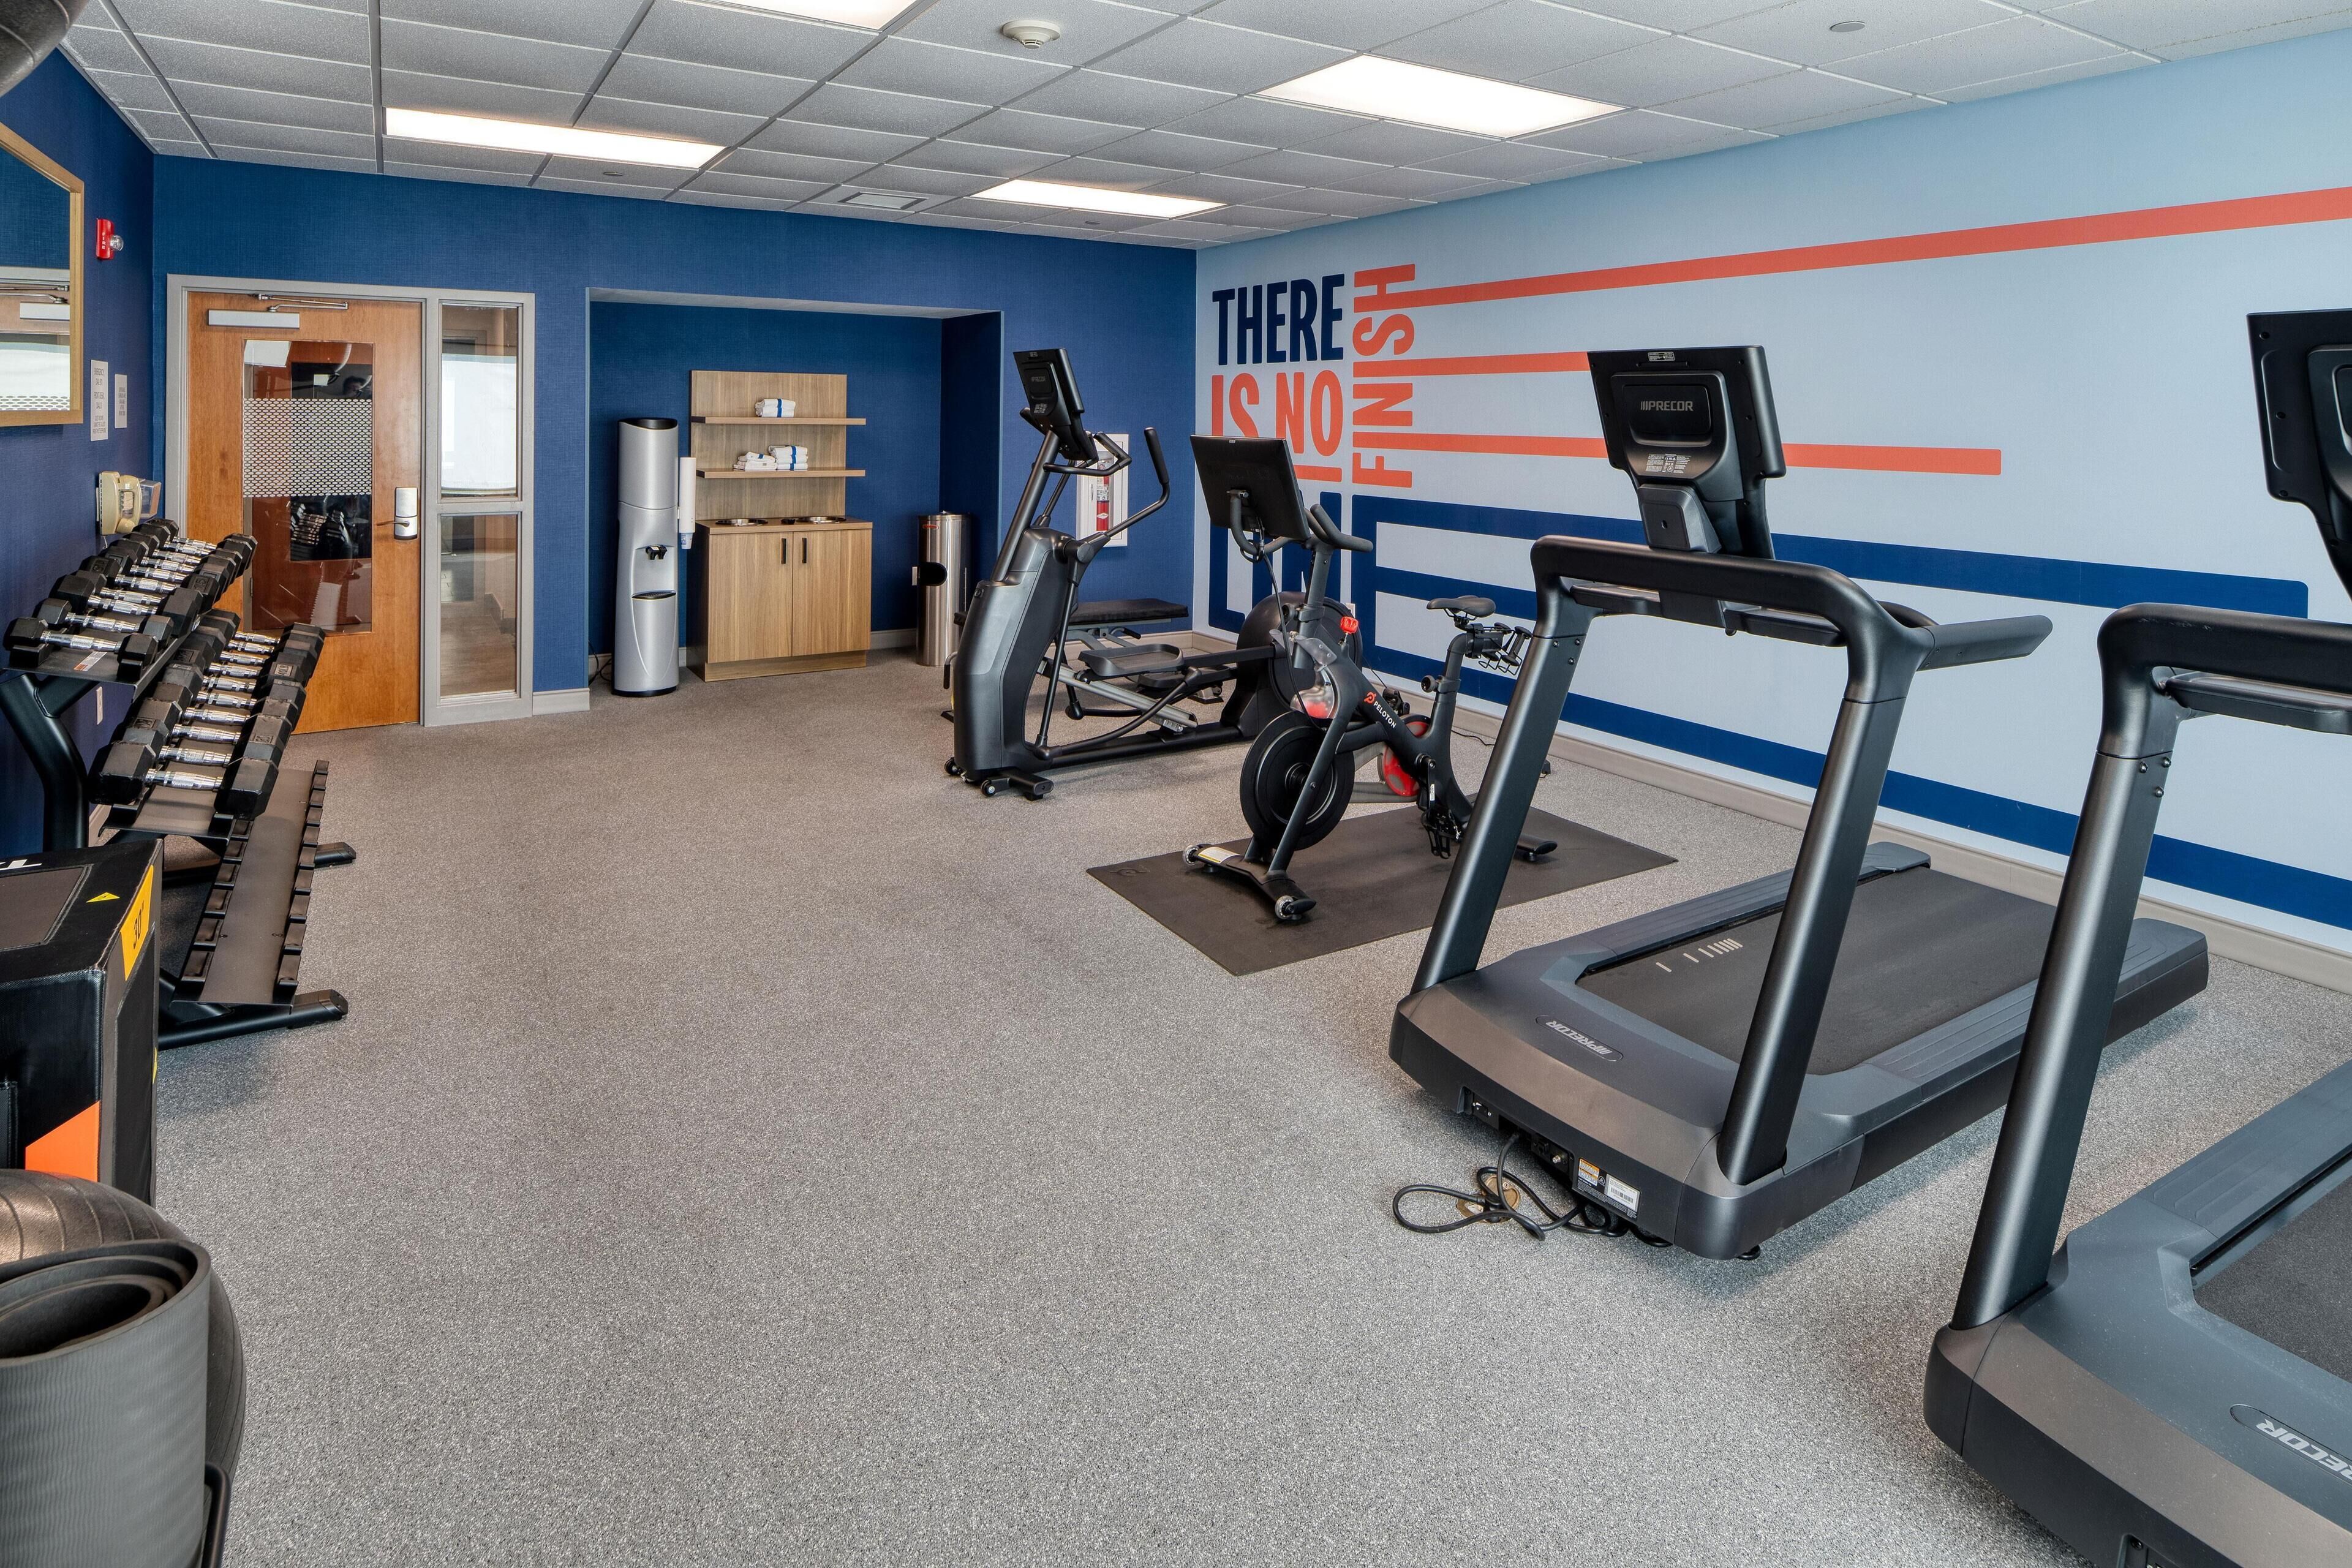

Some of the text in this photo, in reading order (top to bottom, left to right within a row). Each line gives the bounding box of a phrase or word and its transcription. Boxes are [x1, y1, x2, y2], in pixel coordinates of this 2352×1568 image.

[1212, 273, 1344, 366] THERE
[1352, 263, 1415, 488] FINISH
[1212, 369, 1343, 457] IS NO
[1648, 401, 1694, 412] PRECOR
[1373, 701, 1397, 729] PELOTON
[1545, 1020, 1600, 1055] PRECOR
